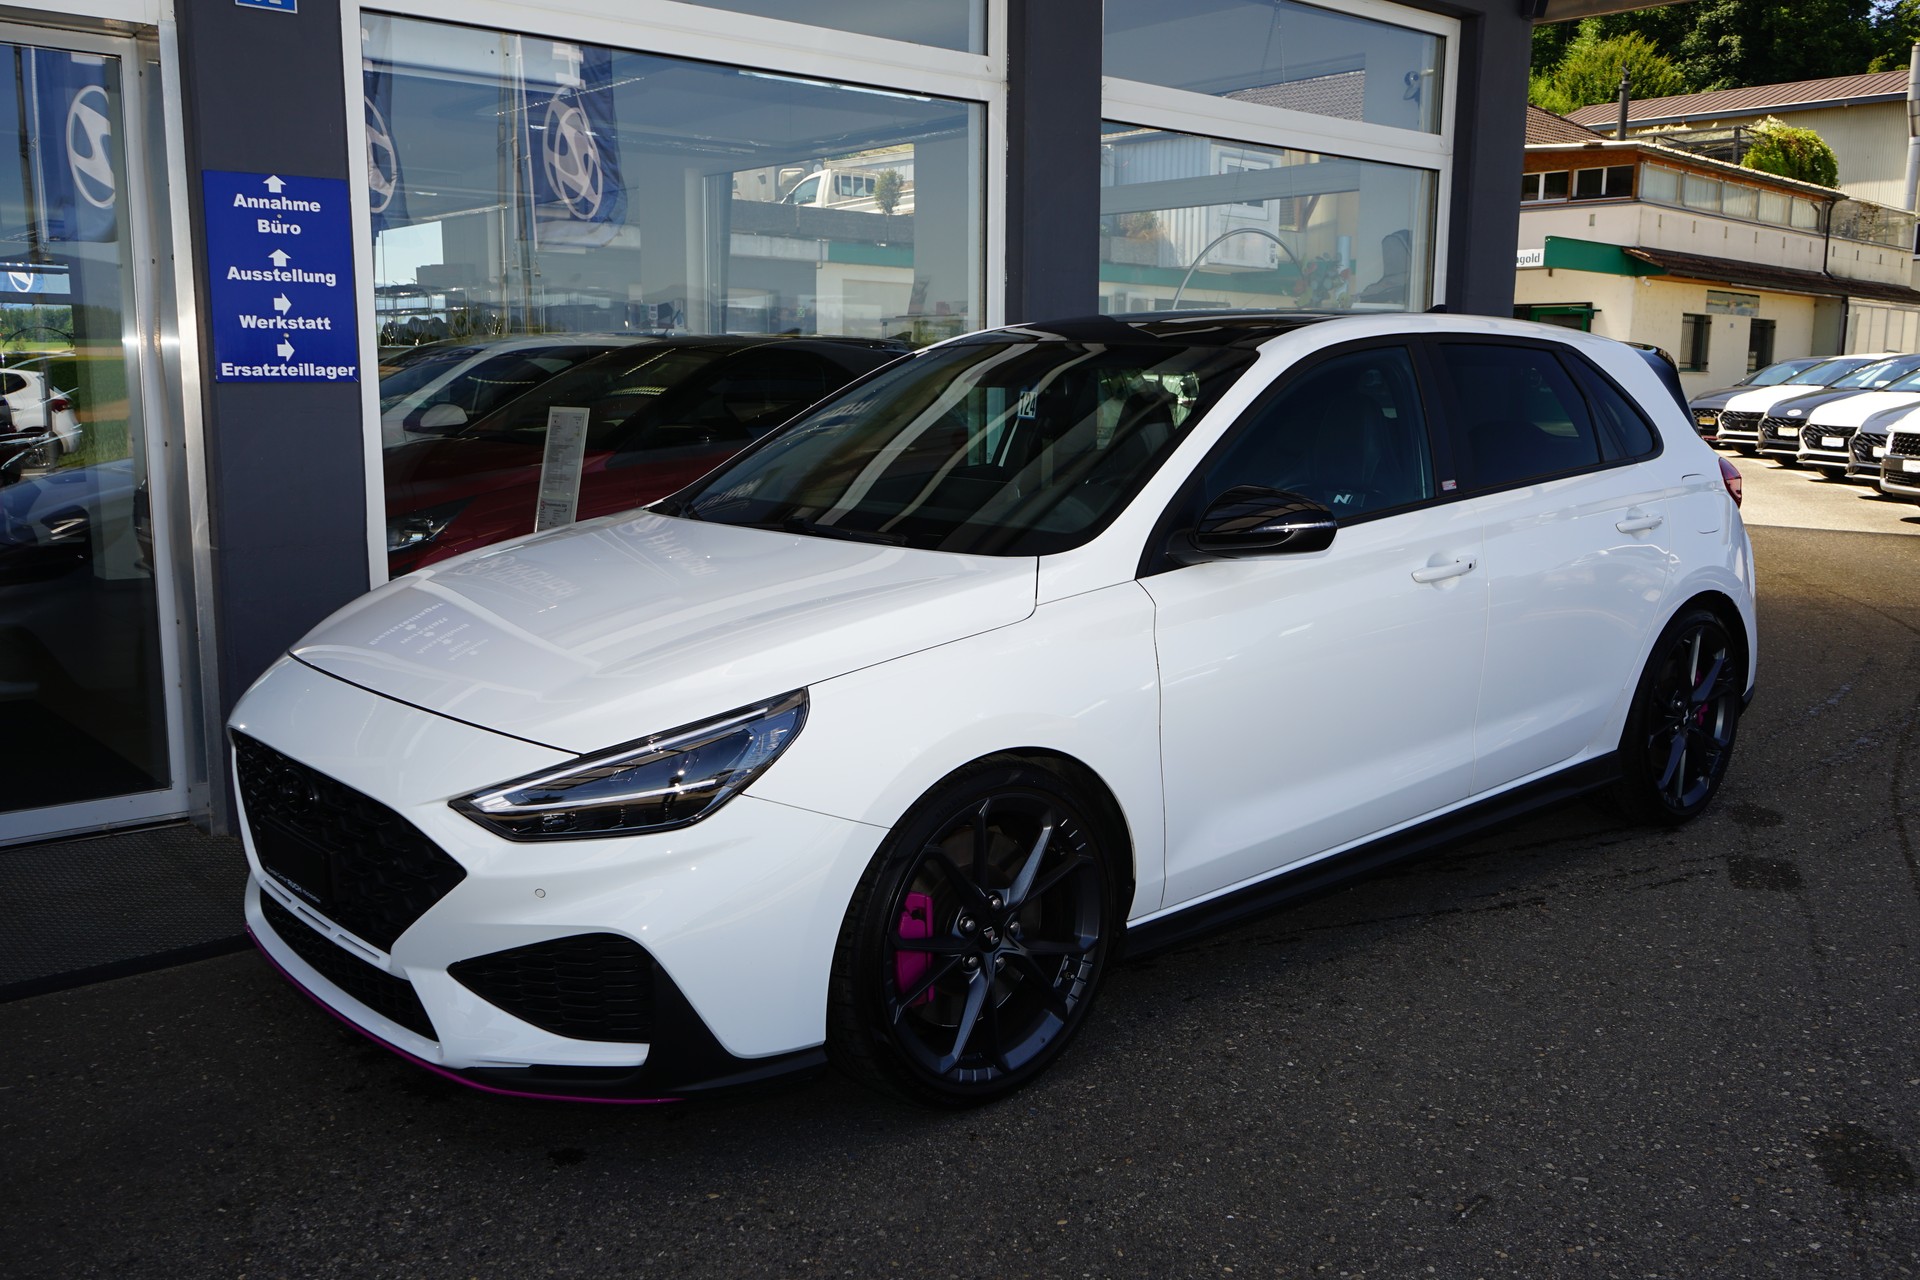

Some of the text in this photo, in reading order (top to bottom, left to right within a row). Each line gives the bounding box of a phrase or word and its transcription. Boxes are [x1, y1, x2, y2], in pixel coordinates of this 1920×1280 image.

[233, 193, 321, 213] Annahme
[257, 219, 302, 235] Büro
[227, 266, 337, 287] Ausstellung
[239, 315, 332, 331] Werkstatt
[221, 362, 356, 380] Ersatzteillager
[1019, 392, 1037, 417] 124
